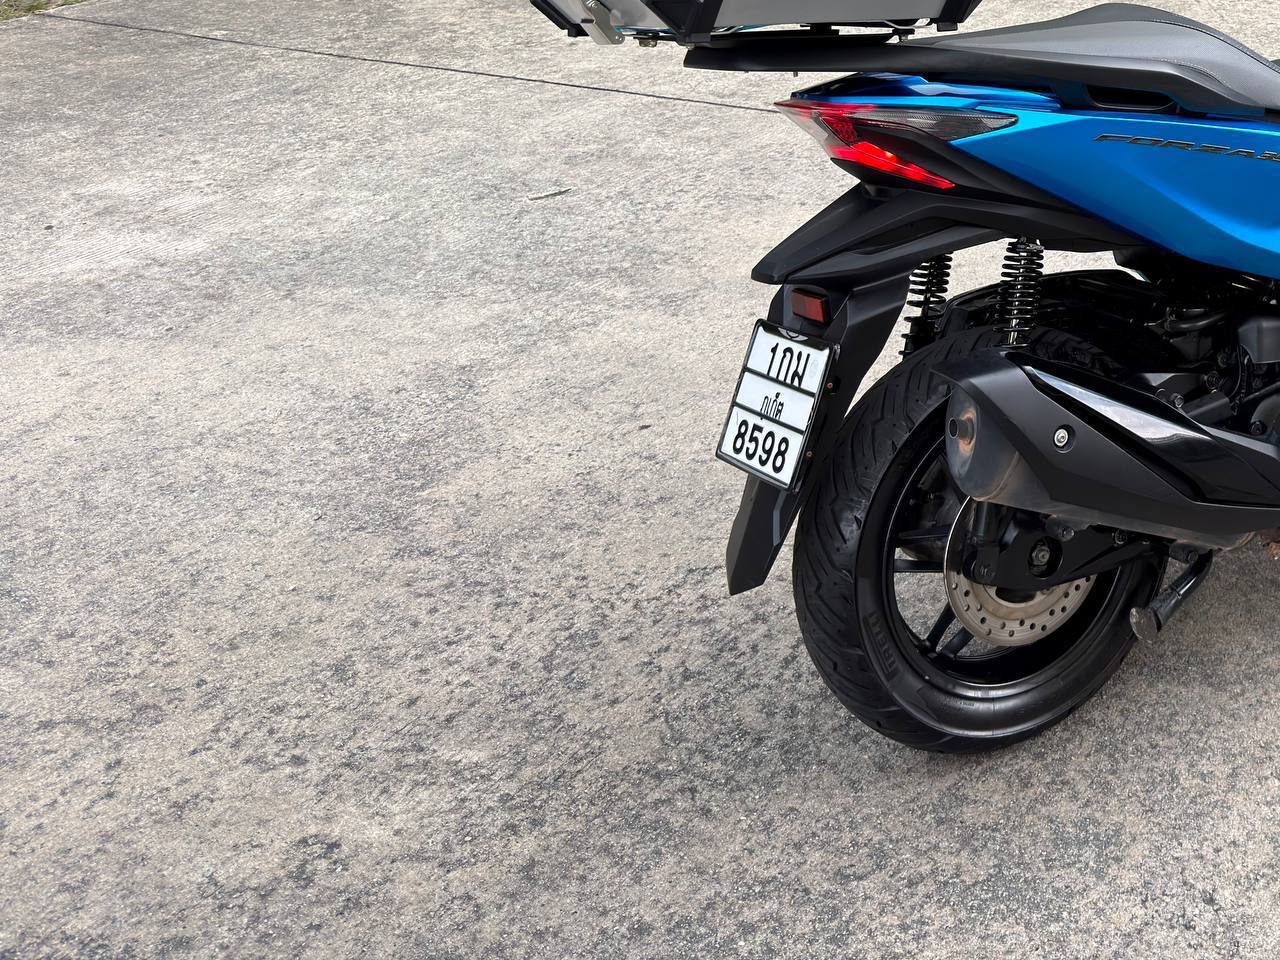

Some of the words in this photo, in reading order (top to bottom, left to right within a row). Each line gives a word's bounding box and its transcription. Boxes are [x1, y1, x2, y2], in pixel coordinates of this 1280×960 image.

[1094, 133, 1255, 159] FORZA
[766, 342, 811, 388] 1กม
[732, 419, 790, 474] 8598
